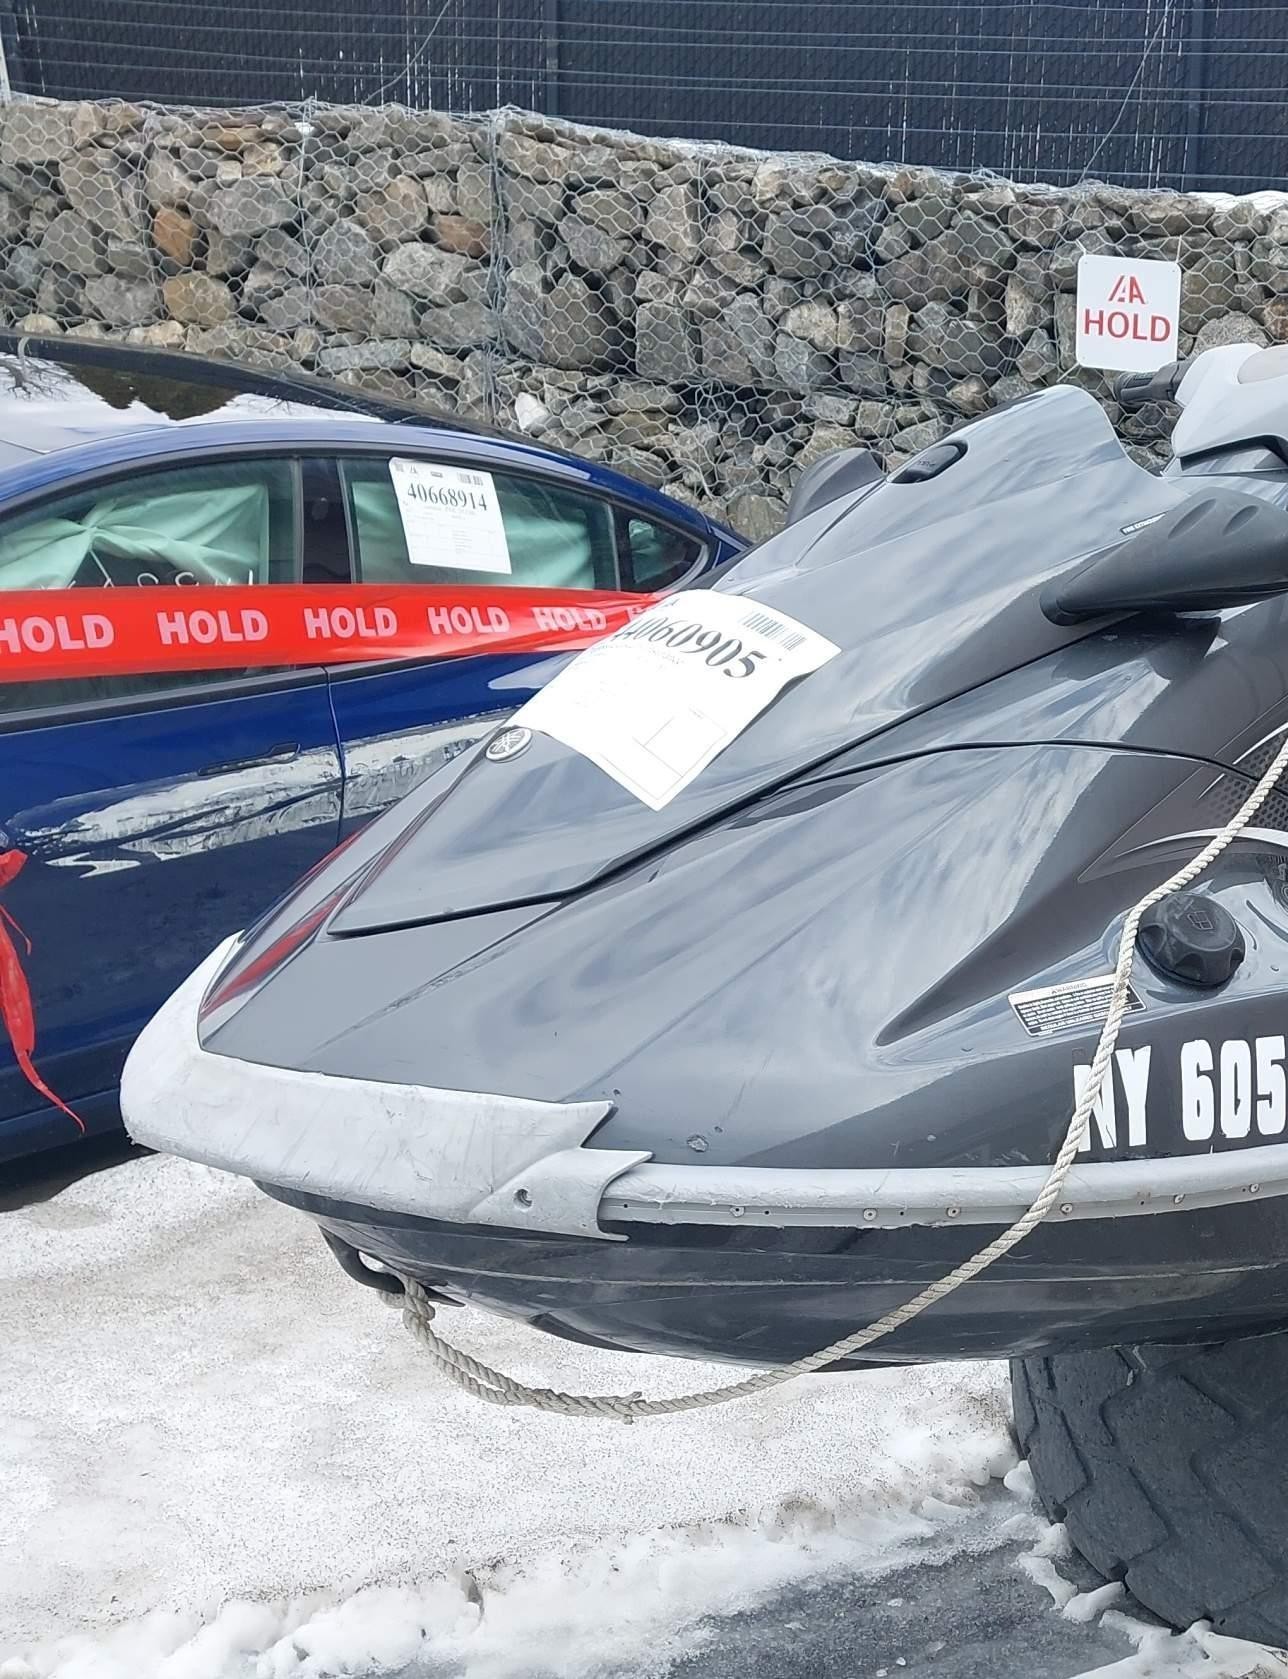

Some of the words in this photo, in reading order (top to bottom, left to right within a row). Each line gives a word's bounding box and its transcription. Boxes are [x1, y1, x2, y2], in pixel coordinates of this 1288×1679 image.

[1084, 308, 1171, 342] HOLD
[407, 482, 488, 511] 40668914
[0, 614, 115, 653] HOLD
[156, 609, 269, 645] HOLD
[303, 606, 398, 639] HOLD
[426, 606, 511, 635] HOLD
[531, 606, 607, 632] HOLD
[1073, 1045, 1151, 1153] NY
